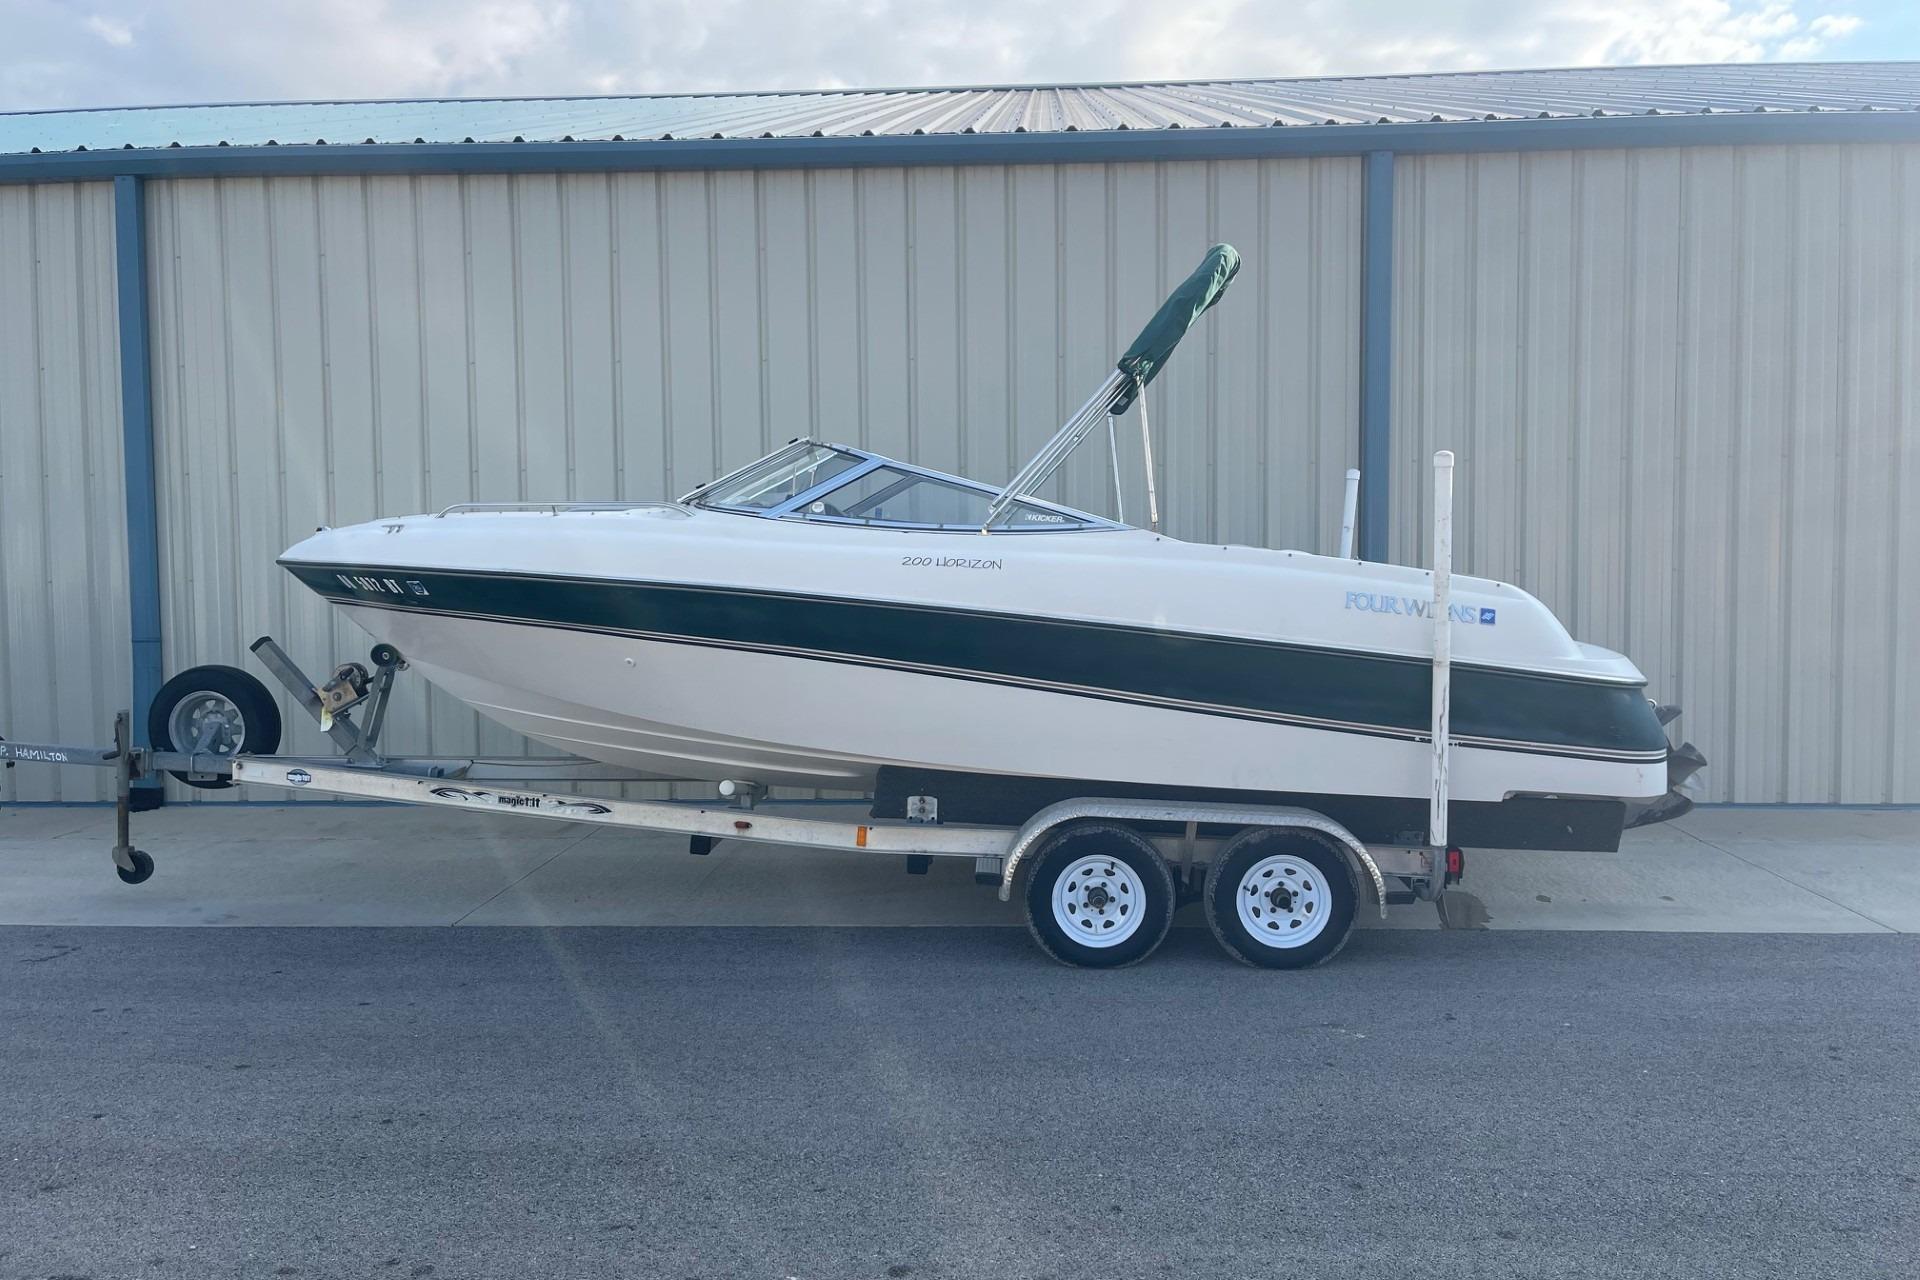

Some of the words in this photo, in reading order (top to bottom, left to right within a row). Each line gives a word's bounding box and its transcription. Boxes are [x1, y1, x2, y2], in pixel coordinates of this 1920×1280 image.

[902, 556, 932, 567] 200
[936, 556, 1002, 570] HORIZON
[1345, 591, 1401, 615] FOUR
[1401, 597, 1477, 624] WINS
[15, 746, 68, 762] HAMILTON
